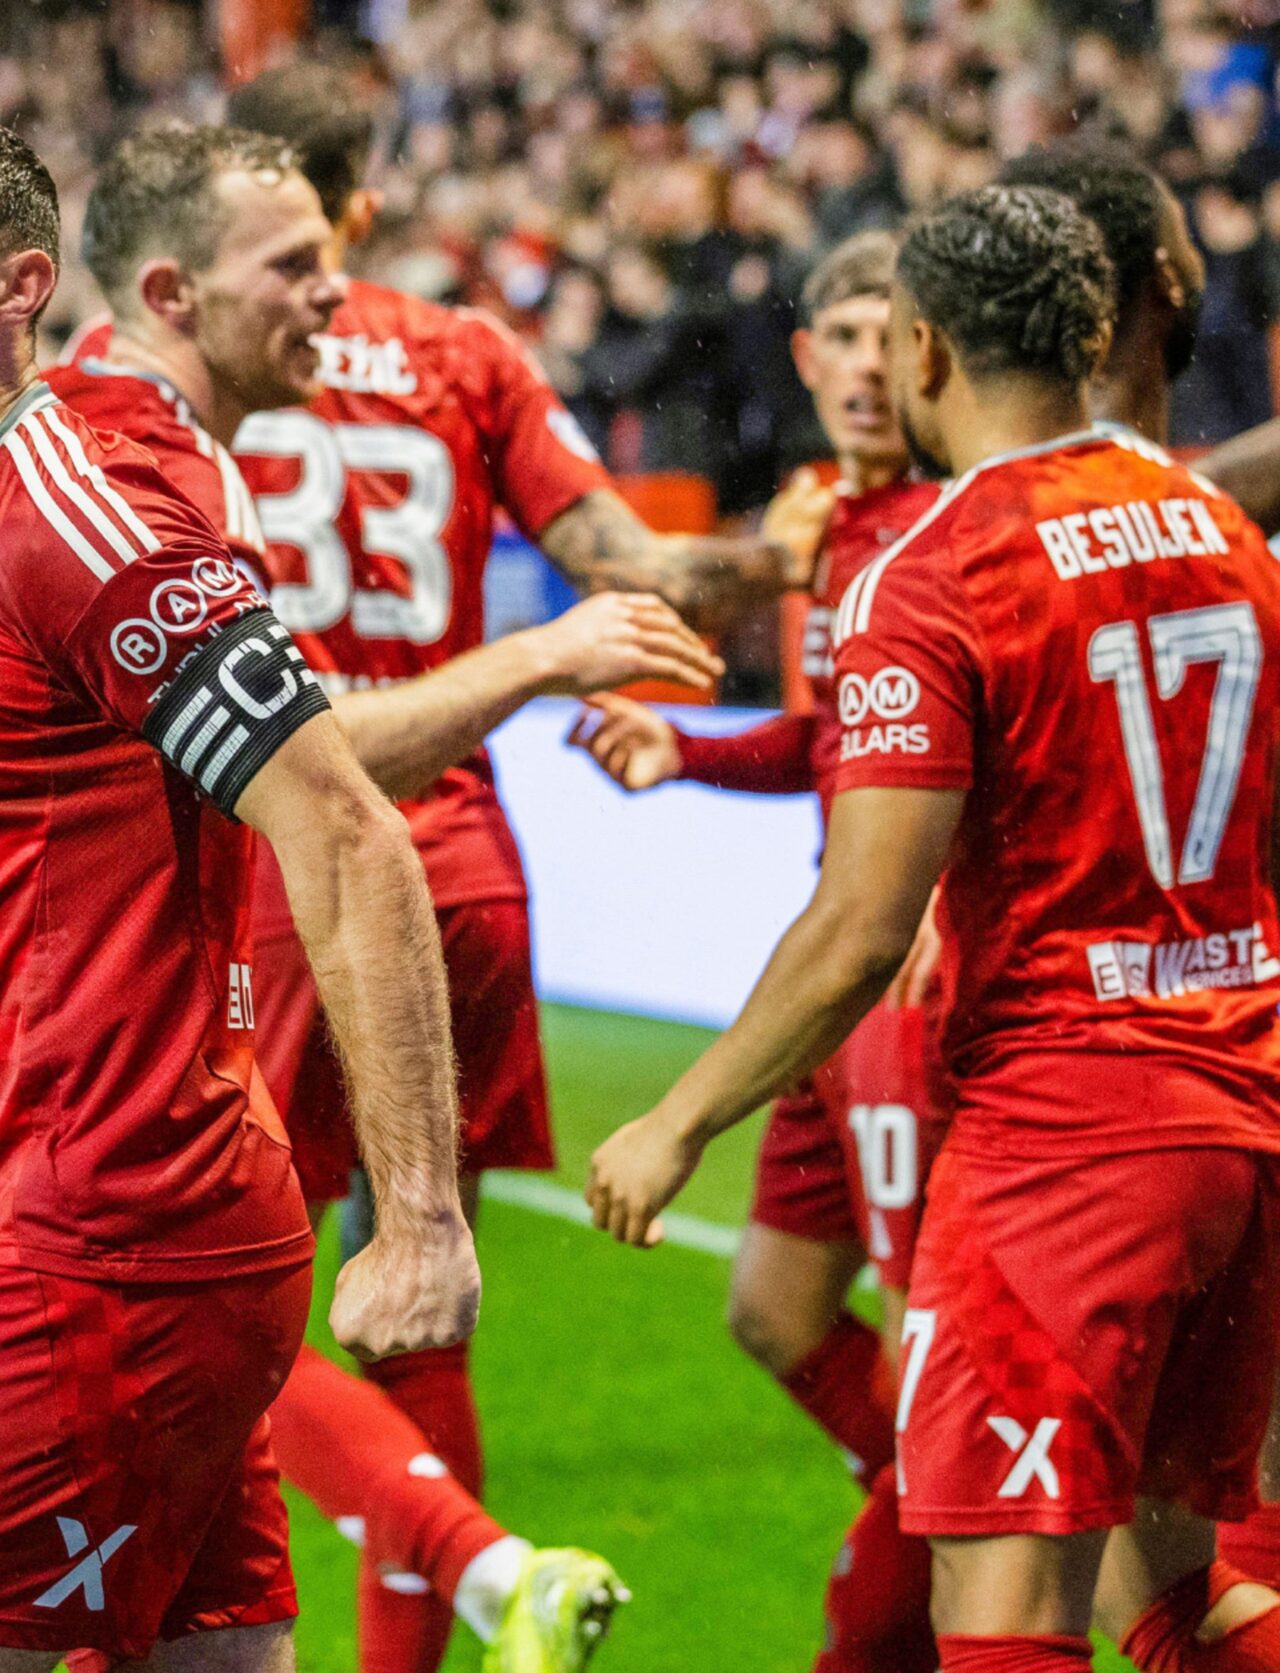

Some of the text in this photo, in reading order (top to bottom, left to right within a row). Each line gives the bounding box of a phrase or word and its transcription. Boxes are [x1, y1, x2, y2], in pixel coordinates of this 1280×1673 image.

[231, 408, 456, 645] 33
[111, 557, 242, 675] RAM
[219, 637, 298, 720] C
[1087, 601, 1263, 890] 17
[850, 1104, 917, 1208] 10
